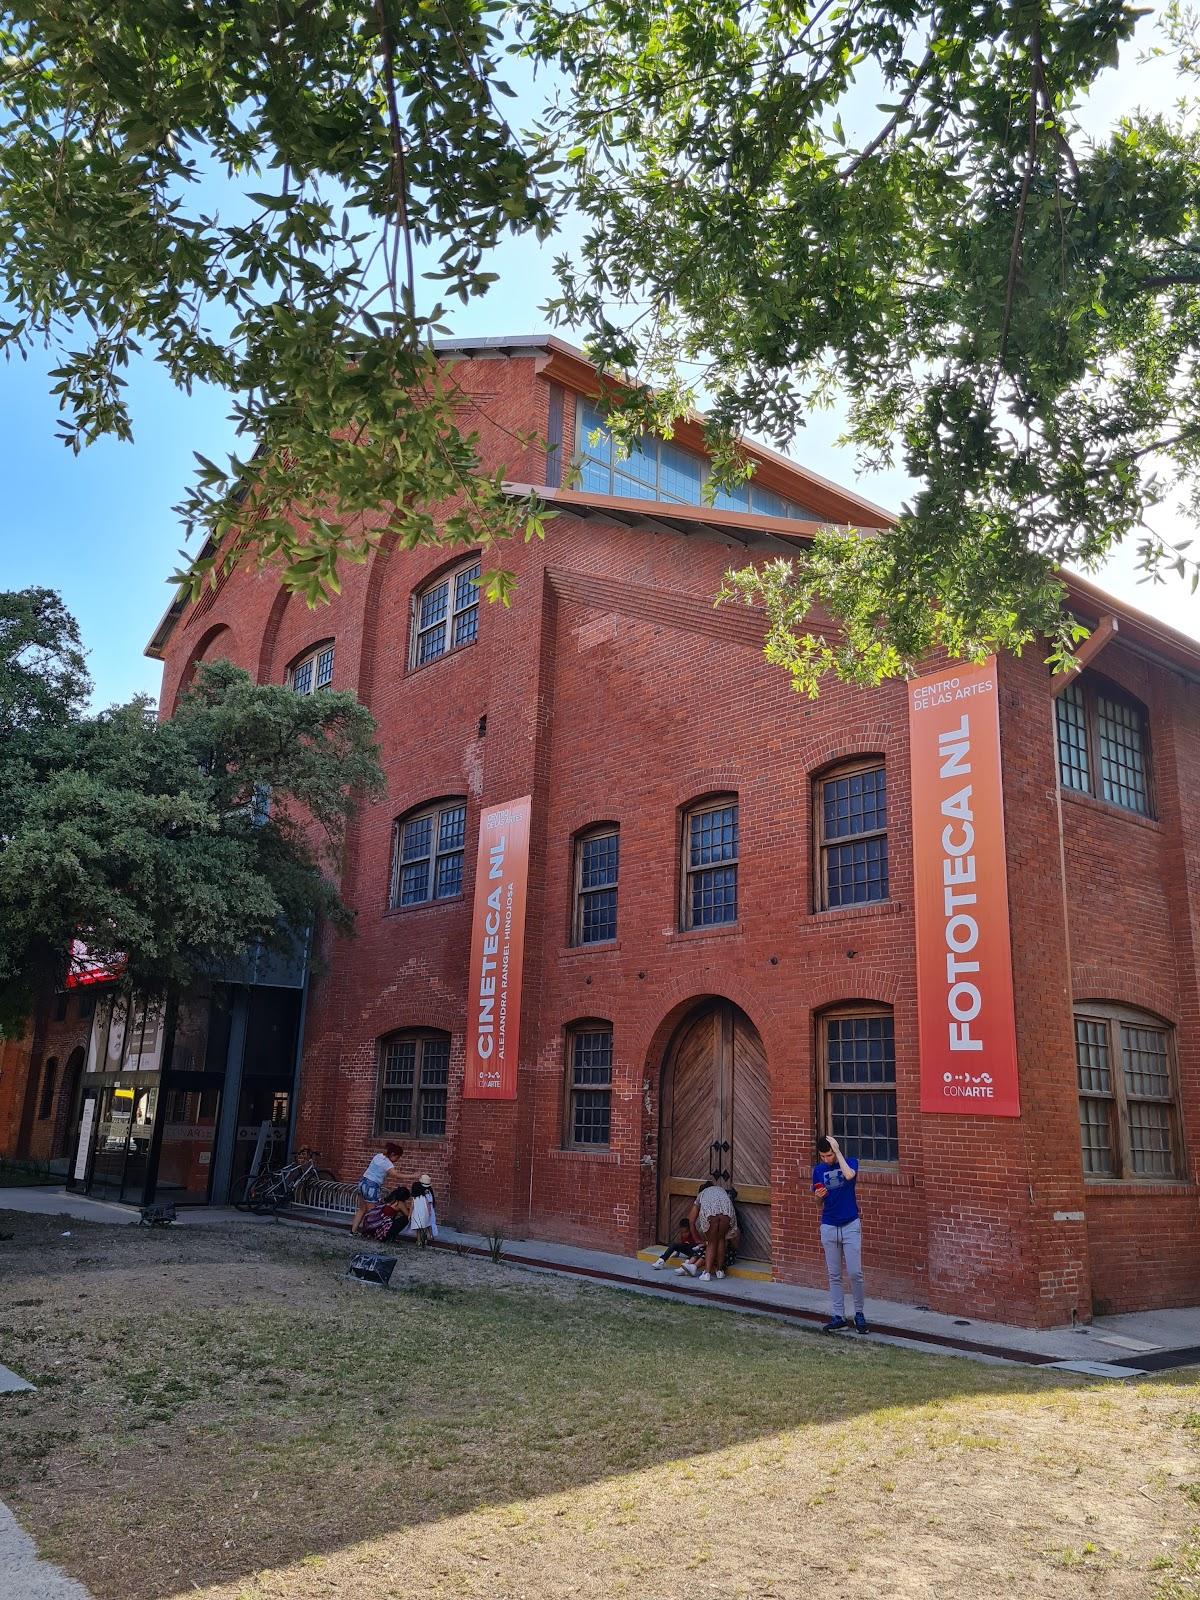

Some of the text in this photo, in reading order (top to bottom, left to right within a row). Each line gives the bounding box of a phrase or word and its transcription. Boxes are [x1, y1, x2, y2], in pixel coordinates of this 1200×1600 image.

[913, 677, 960, 699] CENTRO
[914, 680, 993, 711] DE LAS ARTES
[938, 713, 984, 1051] FOTOTECA NL
[477, 835, 506, 1060] CINETECA NL
[498, 882, 514, 1060] ALEJANDRA RANGEL HINOJOSA
[943, 1085, 994, 1098] CONARTE
